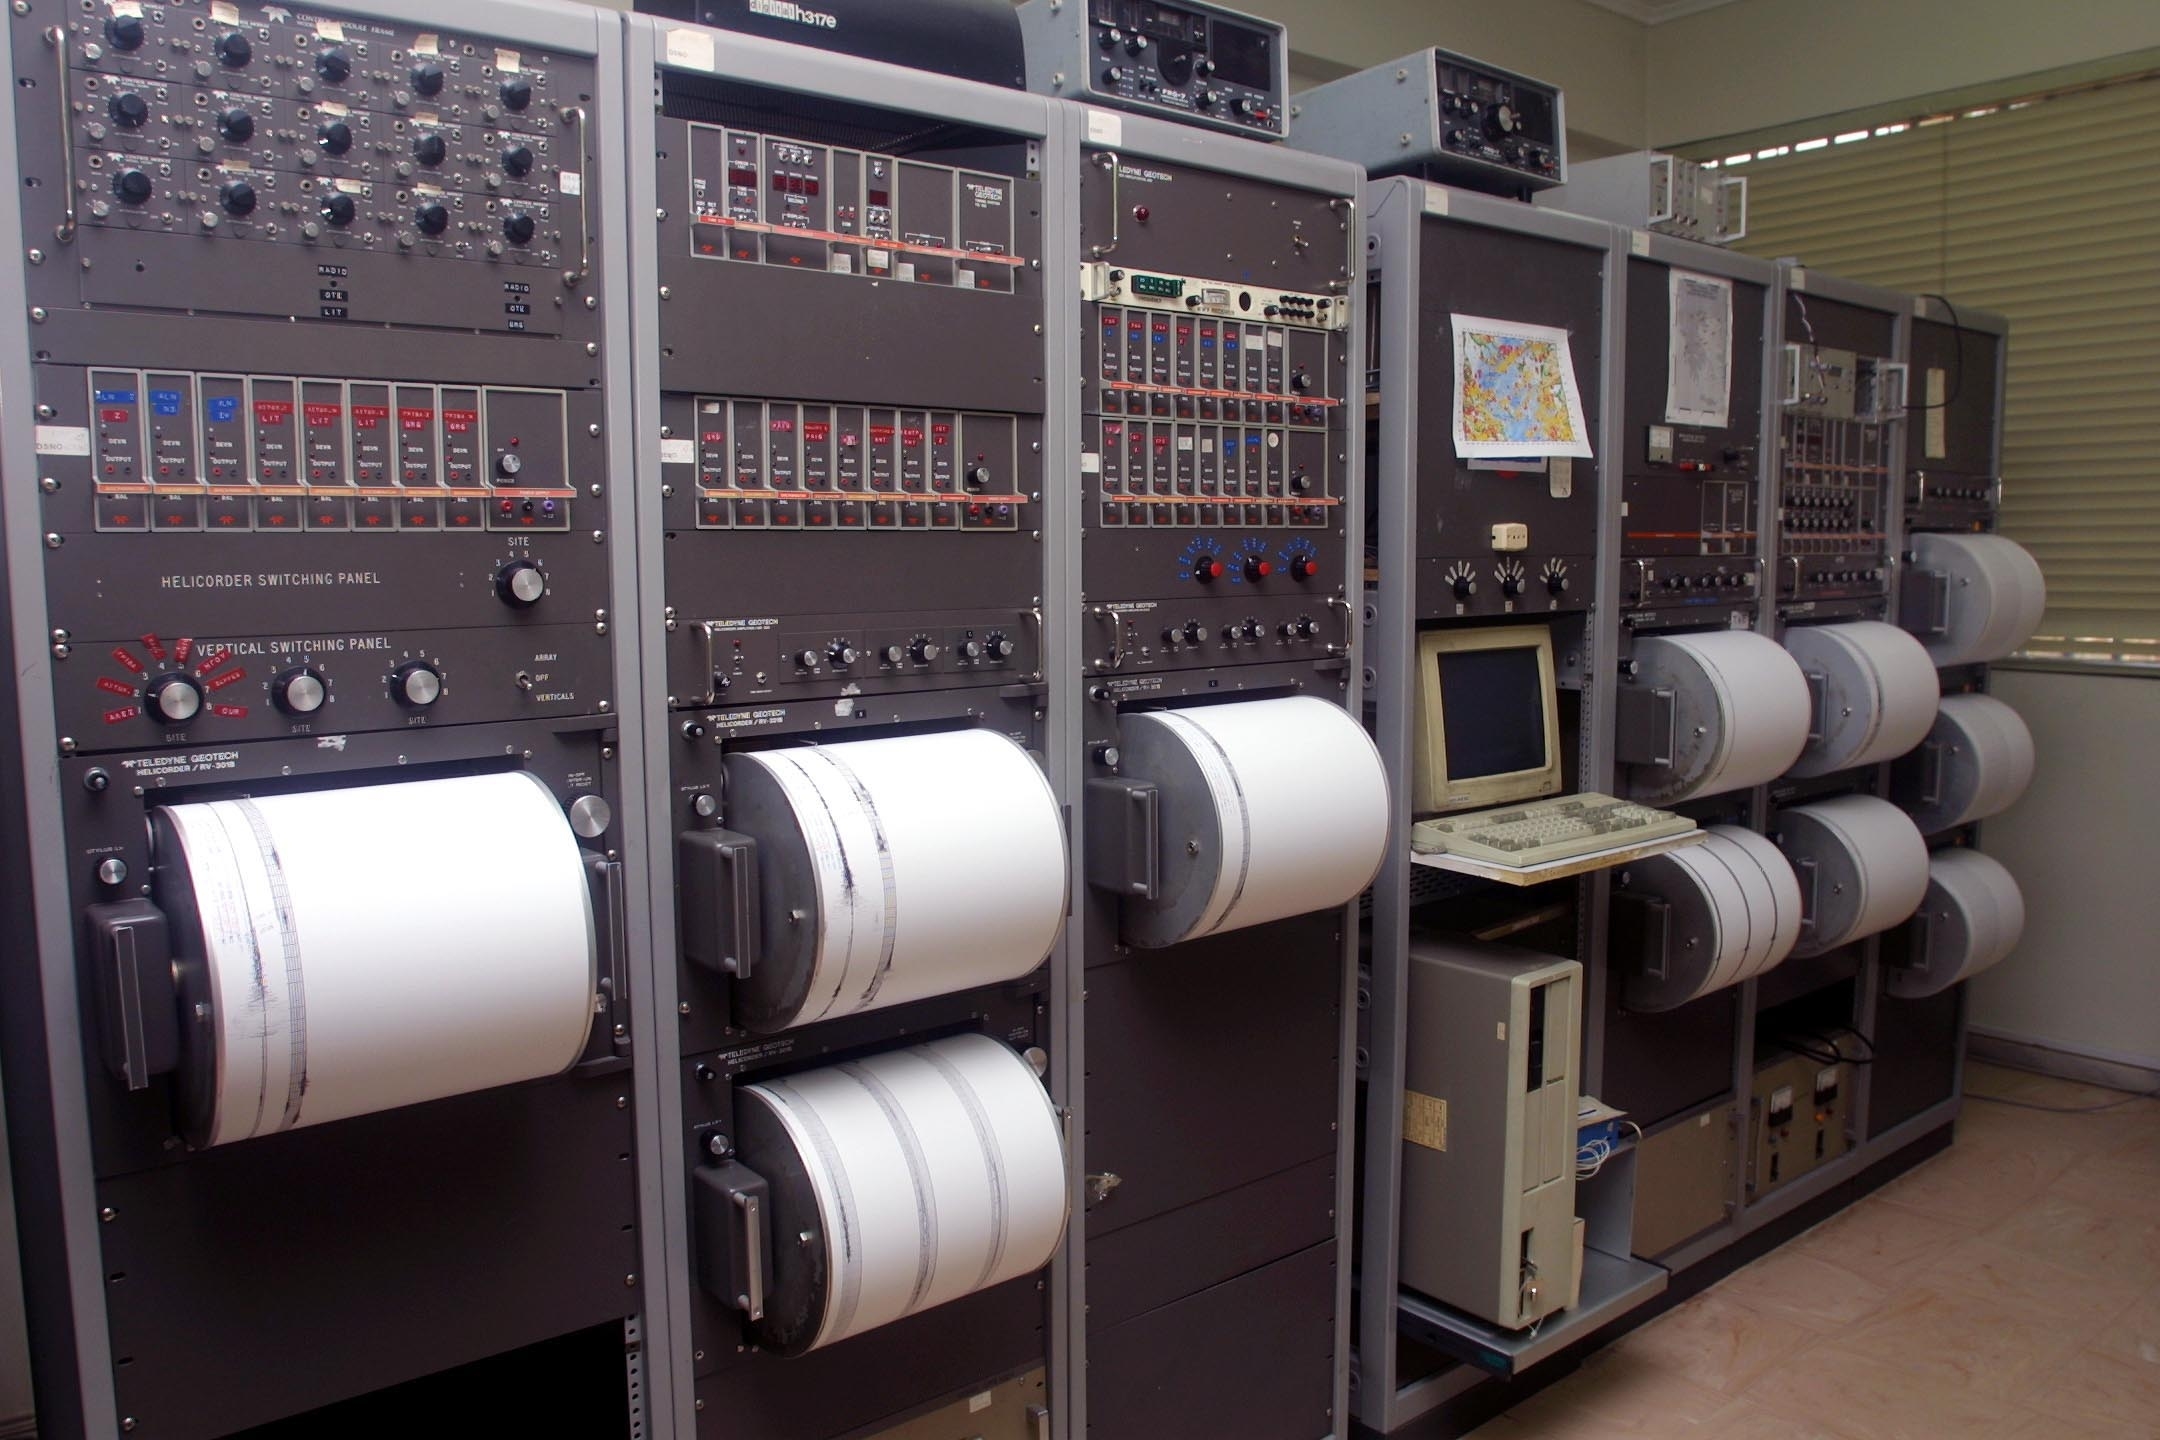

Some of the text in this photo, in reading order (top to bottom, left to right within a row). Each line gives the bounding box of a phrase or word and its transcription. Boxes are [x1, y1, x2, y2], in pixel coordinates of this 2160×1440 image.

[796, 4, 837, 28] h317e
[508, 536, 529, 546] SITE
[161, 572, 380, 588] HELICORDER SWITCHING PANEL
[196, 643, 265, 657] VERTICAL
[271, 639, 345, 653] SWITCHING
[350, 637, 392, 650] PANEL
[534, 653, 557, 661] ARRAY
[535, 692, 575, 702] VERTICALS
[137, 752, 239, 768] TELEDYNE GEOTECH
[136, 766, 191, 776] HELICORDER
